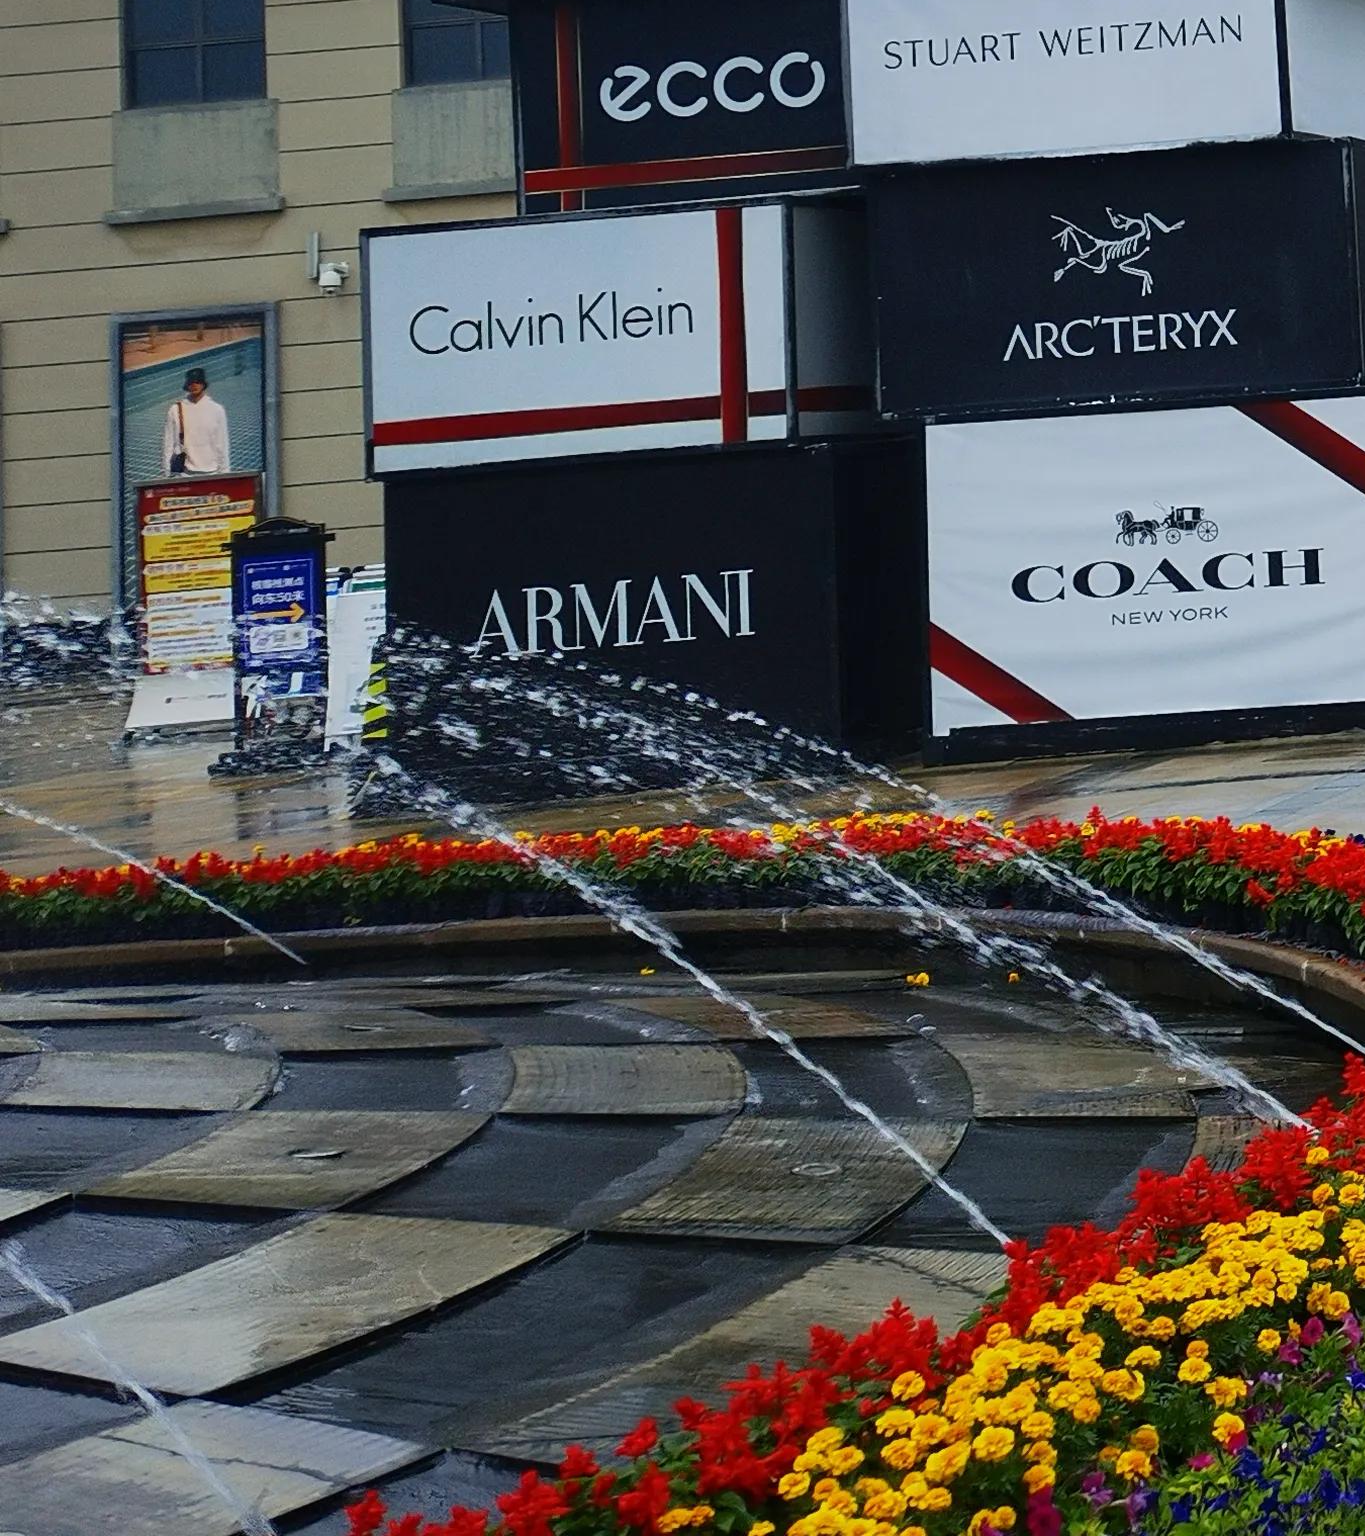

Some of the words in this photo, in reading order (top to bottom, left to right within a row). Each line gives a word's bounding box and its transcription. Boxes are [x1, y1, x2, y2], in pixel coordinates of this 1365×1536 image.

[883, 31, 1020, 71] STUART
[1038, 14, 1243, 58] WEITZMAN
[600, 51, 825, 121] ecco
[409, 294, 565, 355] Calvin
[578, 286, 694, 344] Klein
[1003, 308, 1239, 362] ARC'TERYX
[1011, 547, 1325, 604] COACH
[475, 568, 755, 658] ARMANI
[1112, 608, 1164, 626] NEW
[1168, 605, 1229, 623] YORK
